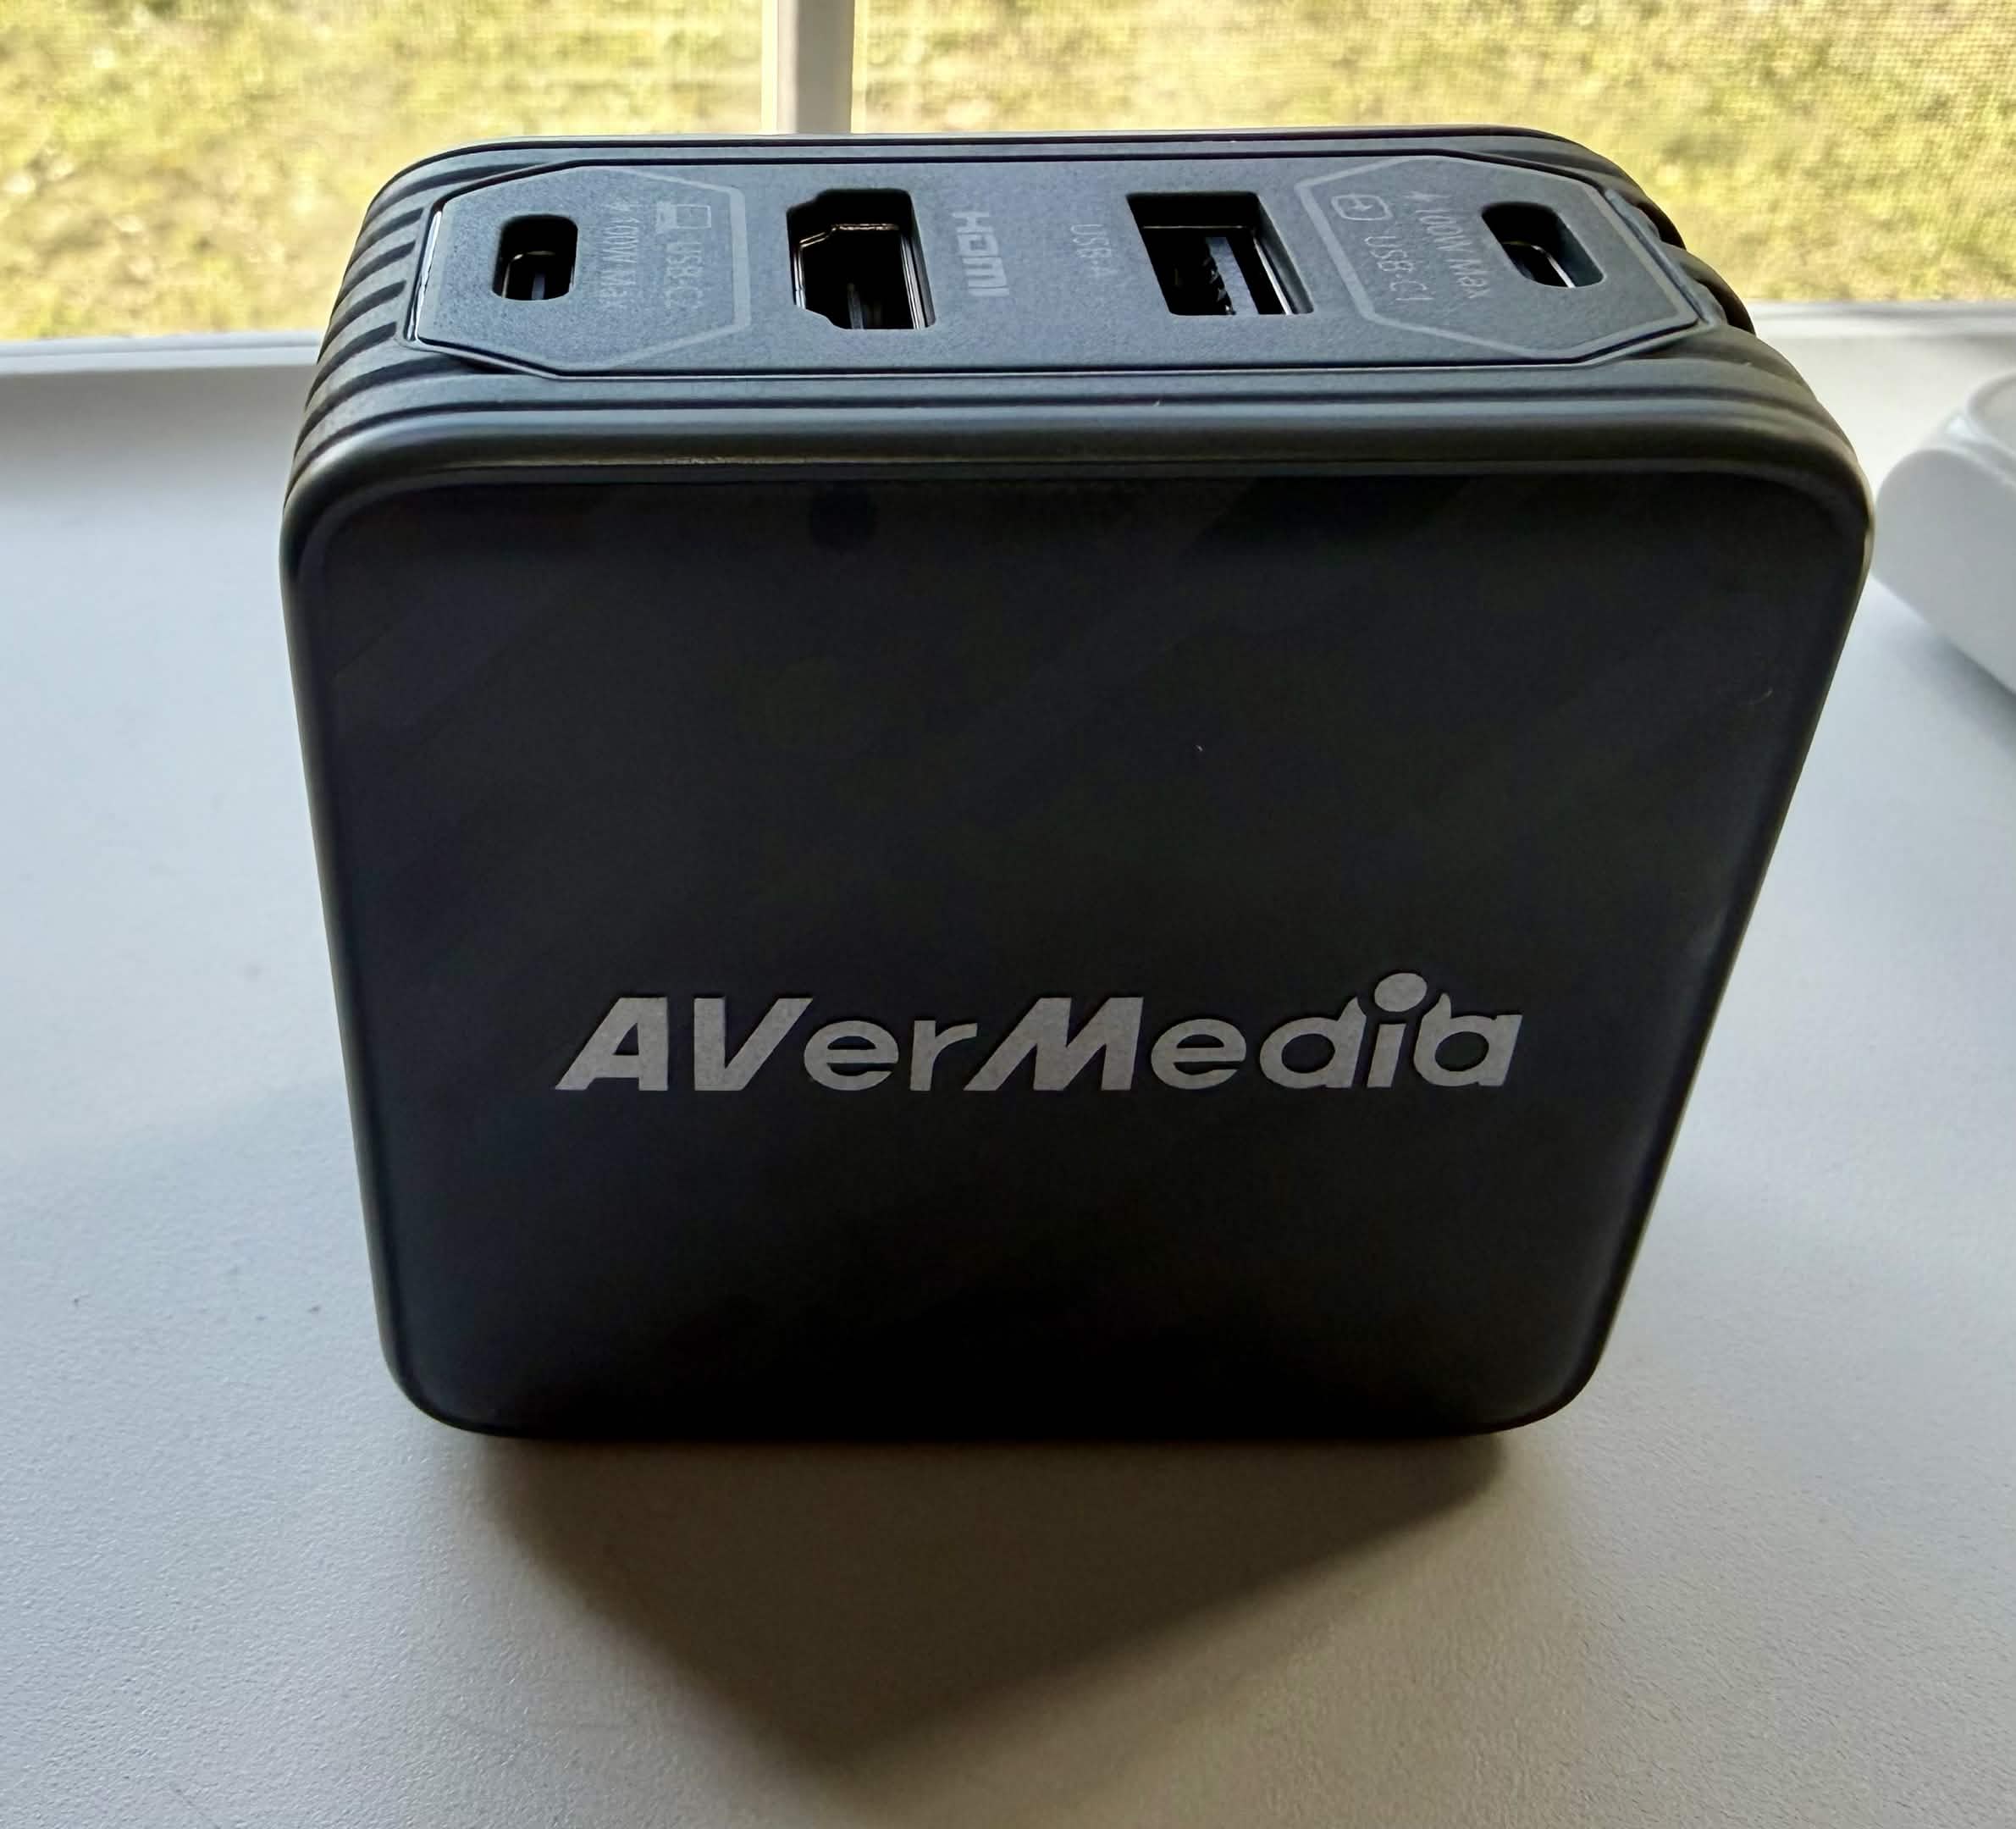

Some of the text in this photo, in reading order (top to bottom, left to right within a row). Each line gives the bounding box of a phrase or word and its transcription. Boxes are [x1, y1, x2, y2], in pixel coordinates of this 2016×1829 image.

[952, 212, 1010, 296] HDMI
[1364, 235, 1434, 301] USB-C1
[1414, 208, 1491, 299] 100W Max
[554, 971, 1523, 1092] AVerMedia
